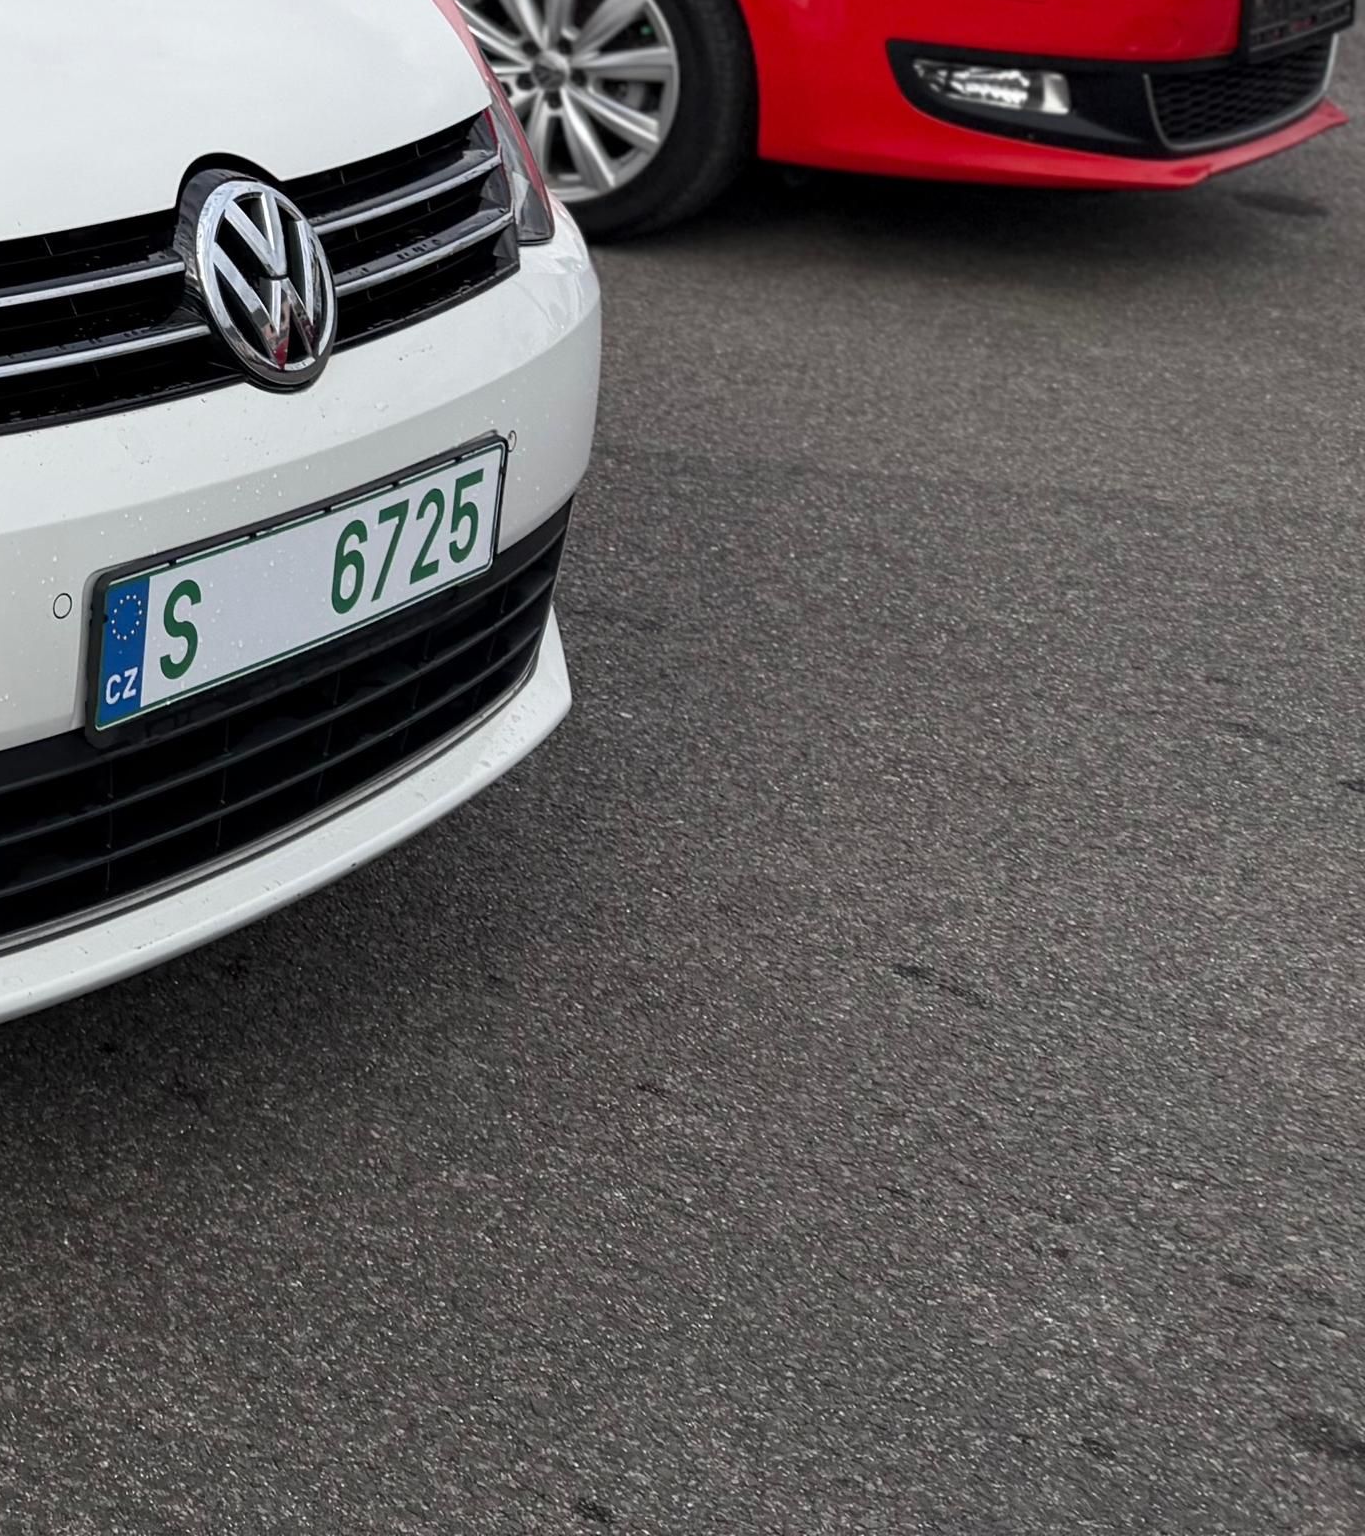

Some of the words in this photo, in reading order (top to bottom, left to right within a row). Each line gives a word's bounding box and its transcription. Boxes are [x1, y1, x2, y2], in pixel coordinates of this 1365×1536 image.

[198, 181, 336, 378] VW
[159, 579, 202, 680] S
[330, 468, 484, 615] 6725
[105, 667, 139, 705] CZ
